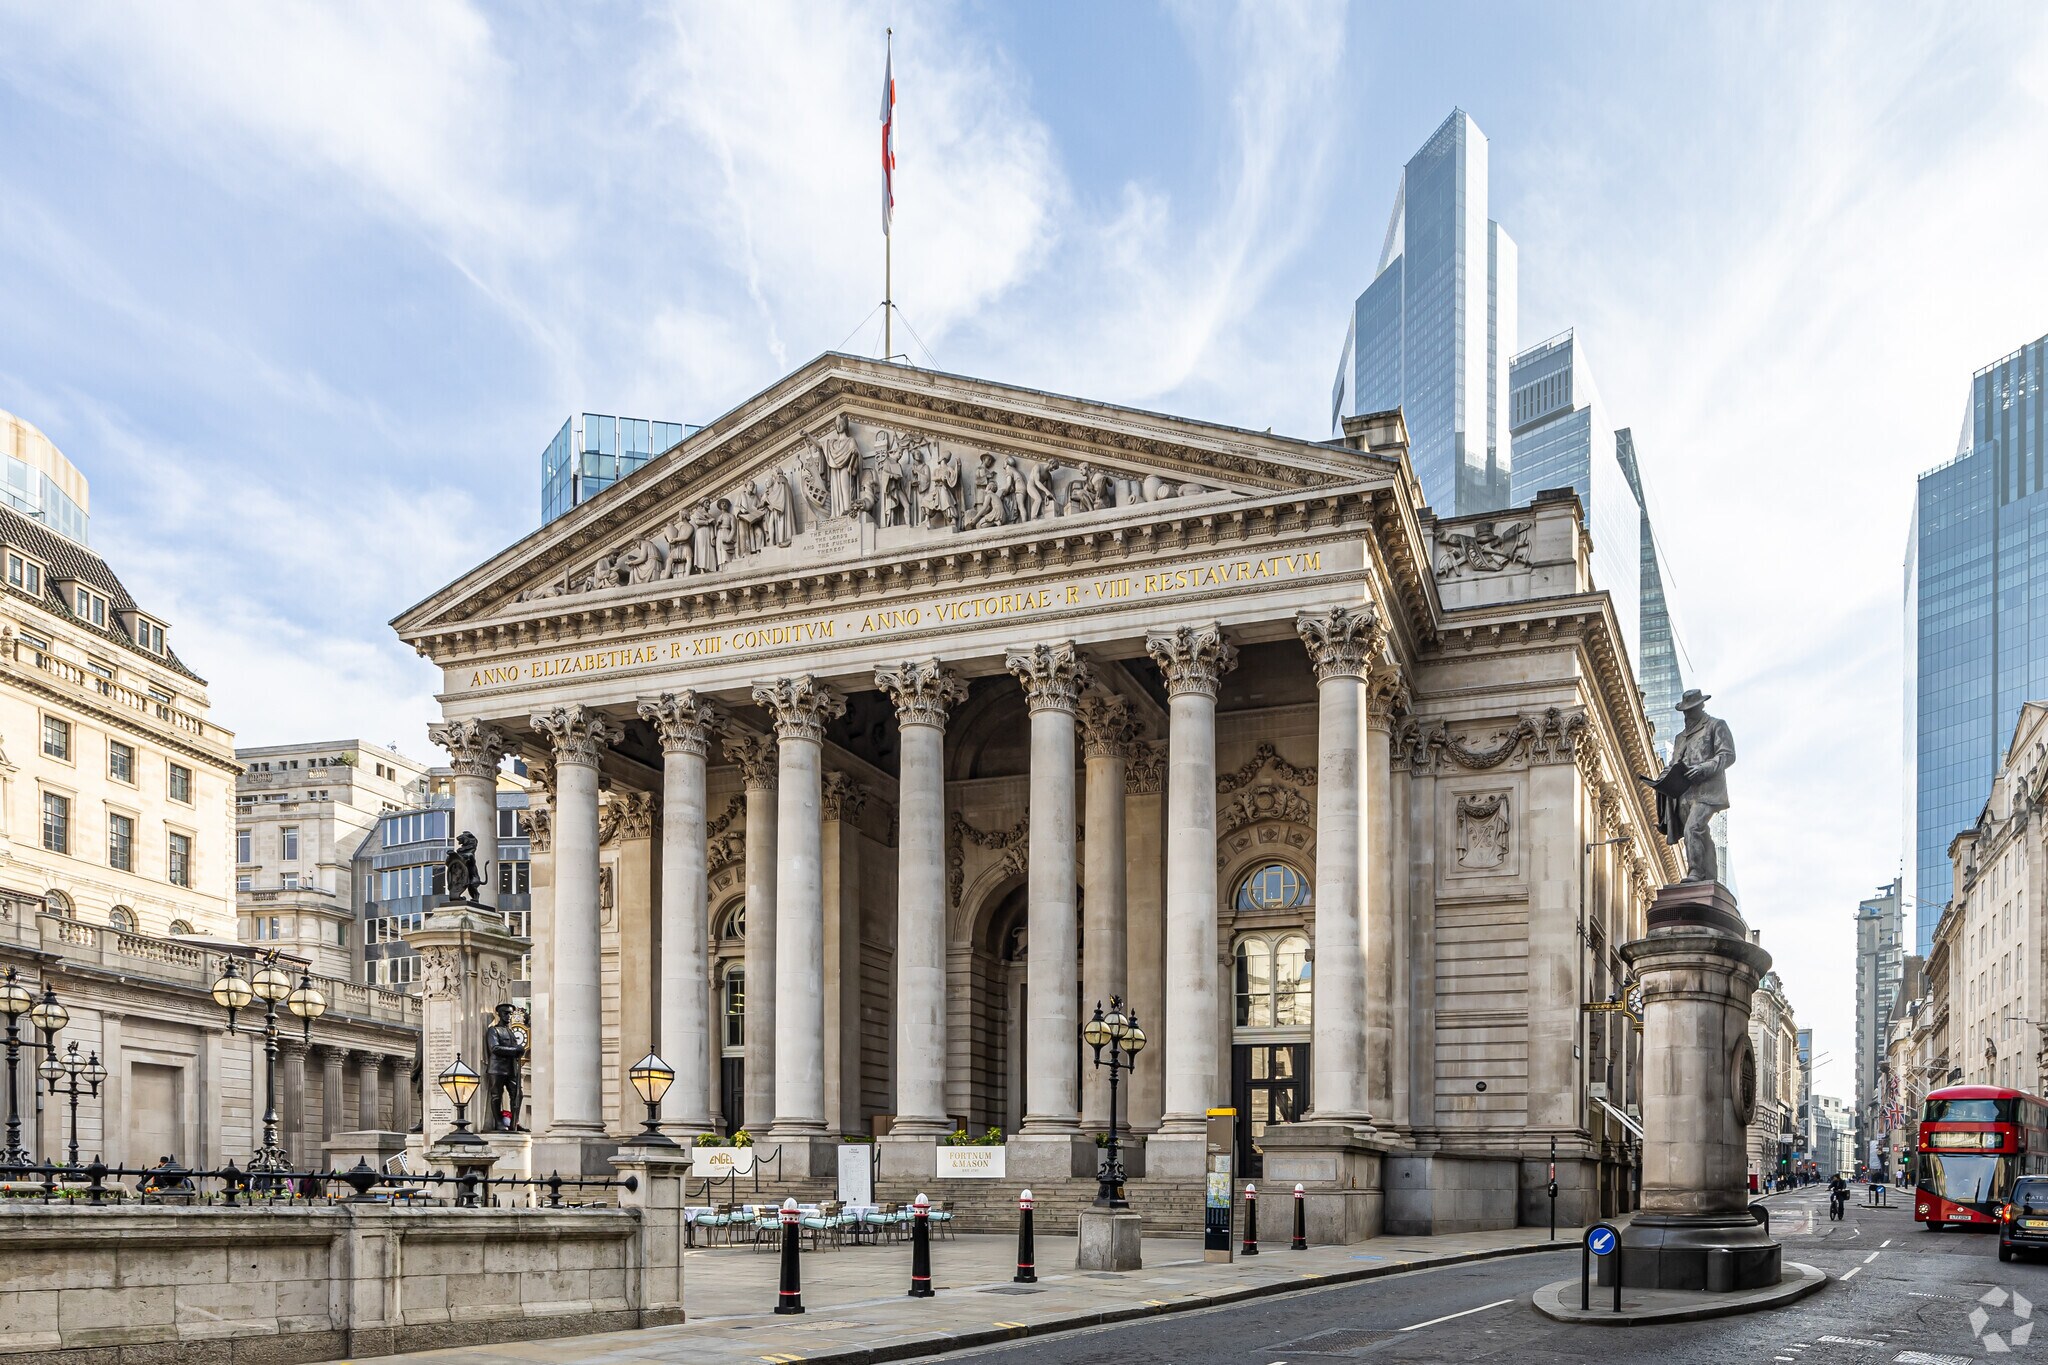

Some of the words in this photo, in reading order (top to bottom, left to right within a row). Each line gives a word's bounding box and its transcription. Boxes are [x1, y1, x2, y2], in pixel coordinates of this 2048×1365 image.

[470, 666, 519, 687] ANNO
[532, 645, 658, 678] ELIZABETHAE
[670, 642, 681, 659] R
[692, 636, 722, 656] XIII
[732, 620, 835, 650] CONDITVM
[860, 608, 921, 633] ANNO
[935, 589, 1052, 622] VICTORIAE
[1066, 586, 1080, 604] R
[1094, 578, 1130, 600] VIII
[1144, 552, 1322, 594] RESTAVRATVM
[1987, 1135, 1994, 1144] 8
[710, 1152, 734, 1164] ENGEL
[949, 1152, 992, 1160] FORTNUM
